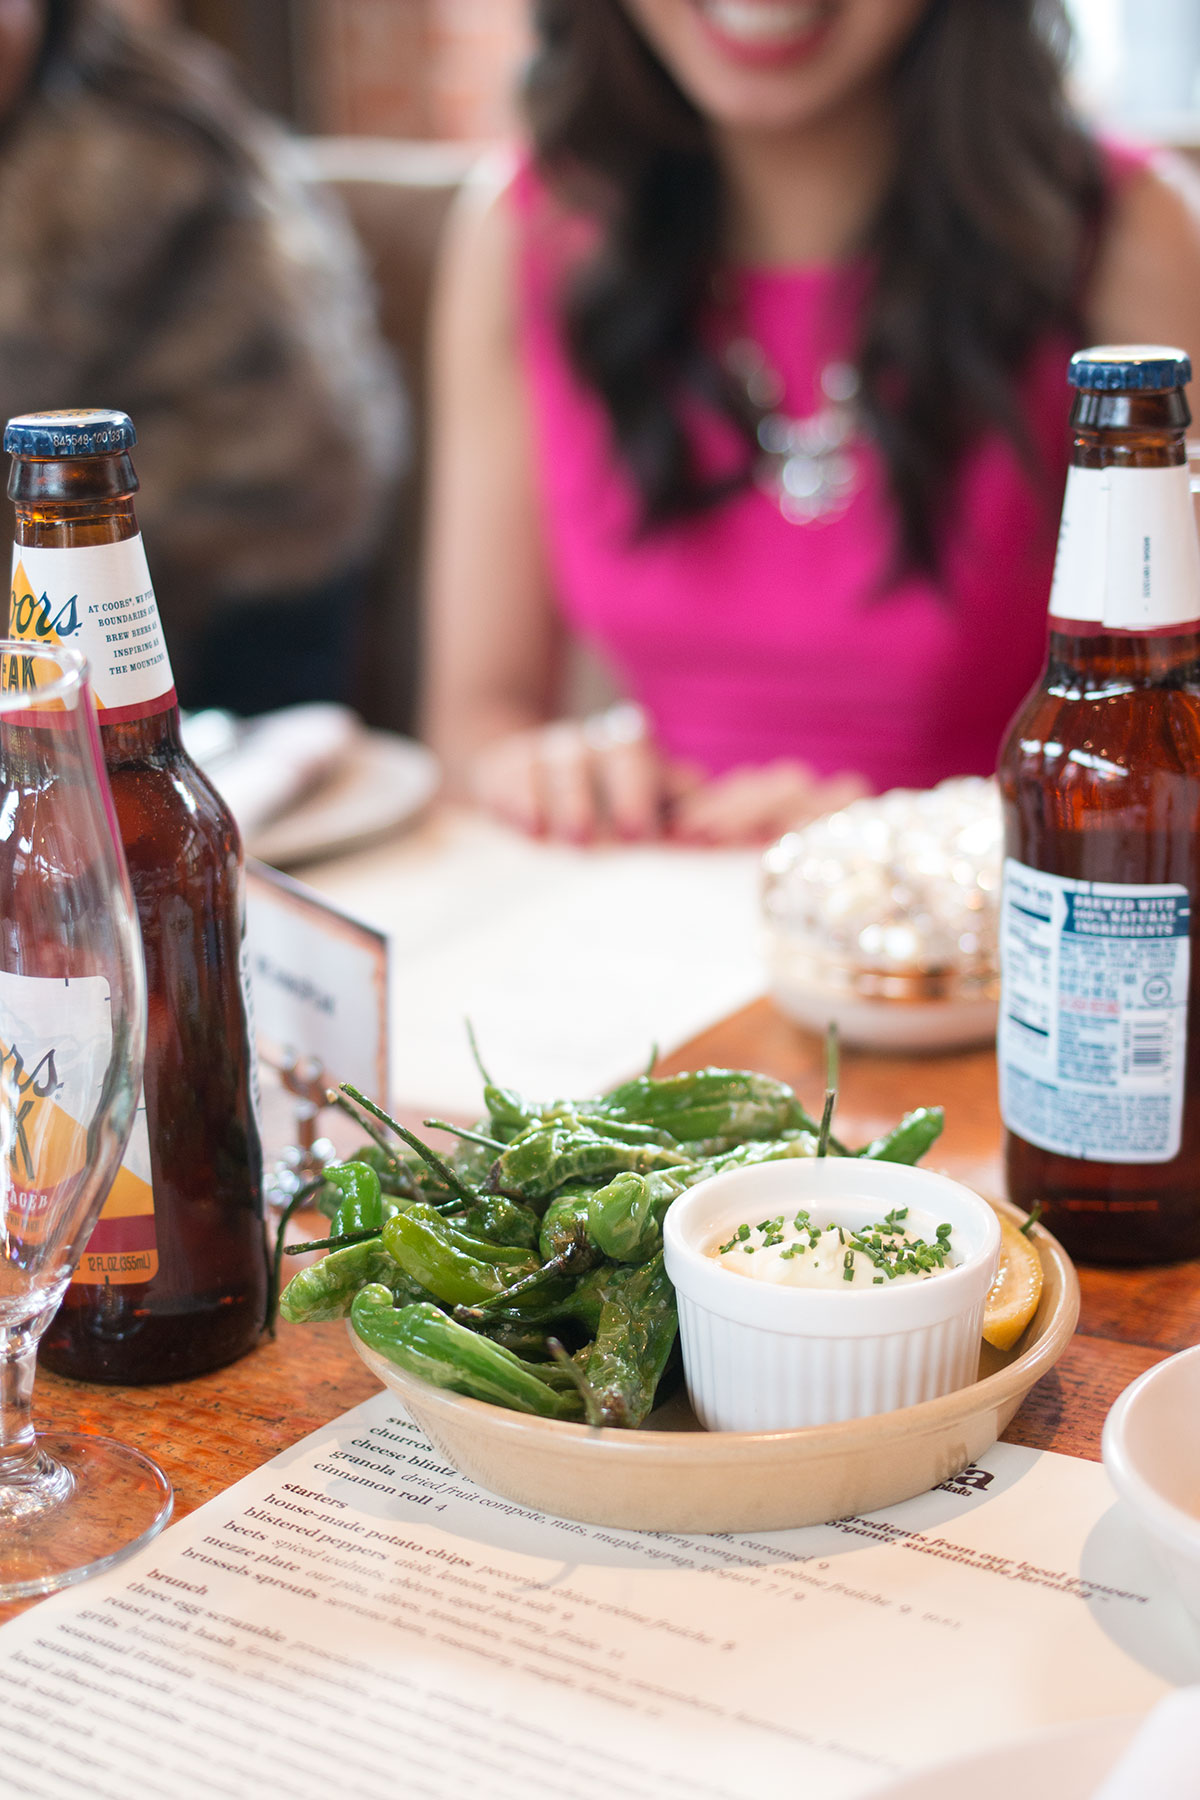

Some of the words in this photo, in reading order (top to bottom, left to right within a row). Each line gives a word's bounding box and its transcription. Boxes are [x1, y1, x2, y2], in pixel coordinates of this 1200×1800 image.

[88, 605, 99, 613] AT
[98, 608, 147, 627] BOUNDARIES
[106, 632, 129, 643] BREW
[131, 624, 151, 638] BEERS
[113, 641, 152, 658] INSPIRING
[109, 665, 128, 676] THE
[1074, 894, 1135, 911] BREWED
[1138, 898, 1176, 911] WITH
[1110, 911, 1176, 923] NATURAL
[1075, 920, 1173, 936] INGREDIENTS
[9, 1189, 48, 1210] AGER
[88, 1256, 96, 1271] 12
[281, 1483, 350, 1509] starters
[313, 1463, 398, 1495] cinnamon
[398, 1491, 435, 1506] roll
[434, 1504, 449, 1512] 4
[369, 1427, 436, 1452] churros
[740, 1540, 818, 1564] caramel
[818, 1562, 831, 1570] 9
[328, 1451, 397, 1476] granola
[400, 1473, 448, 1491] dried
[435, 1486, 481, 1502] fruit
[478, 1498, 547, 1524] compote,
[550, 1515, 588, 1537] nuts,
[592, 1532, 646, 1551] maple
[643, 1548, 697, 1570] syrup,
[697, 1563, 762, 1586] yogurt
[350, 1439, 408, 1461] cheese
[407, 1455, 459, 1477] blintz
[695, 1545, 769, 1569] compote,
[263, 1493, 367, 1533] house-made
[363, 1530, 425, 1552] potato
[425, 1549, 473, 1568] chips
[202, 1535, 257, 1557] mezze
[253, 1553, 302, 1572] plate
[304, 1570, 338, 1582] our
[222, 1520, 270, 1541] beets
[271, 1539, 327, 1559] spiced
[320, 1555, 386, 1580] walnuts,
[243, 1506, 322, 1538] blistered
[315, 1534, 388, 1561] peppers
[393, 1559, 437, 1577] aioli,
[435, 1569, 489, 1594] lemon,
[825, 1521, 897, 1546] organic,
[902, 1541, 1011, 1576] sustainable
[1007, 1571, 1093, 1599] farming
[840, 1516, 928, 1542] gredients
[924, 1538, 976, 1556] from
[980, 1552, 1015, 1566] our
[1017, 1561, 1067, 1580] local
[1064, 1577, 1150, 1603] growers
[146, 1568, 210, 1596] brunch
[181, 1546, 251, 1576] brussels
[252, 1573, 320, 1600] sprouts
[75, 1610, 120, 1629] grits
[103, 1596, 150, 1617] roast
[146, 1613, 191, 1632] pork
[193, 1627, 238, 1649] hash
[126, 1582, 173, 1602] three
[173, 1600, 205, 1616] egg
[204, 1611, 288, 1643] scramble
[56, 1624, 135, 1655] seasonal
